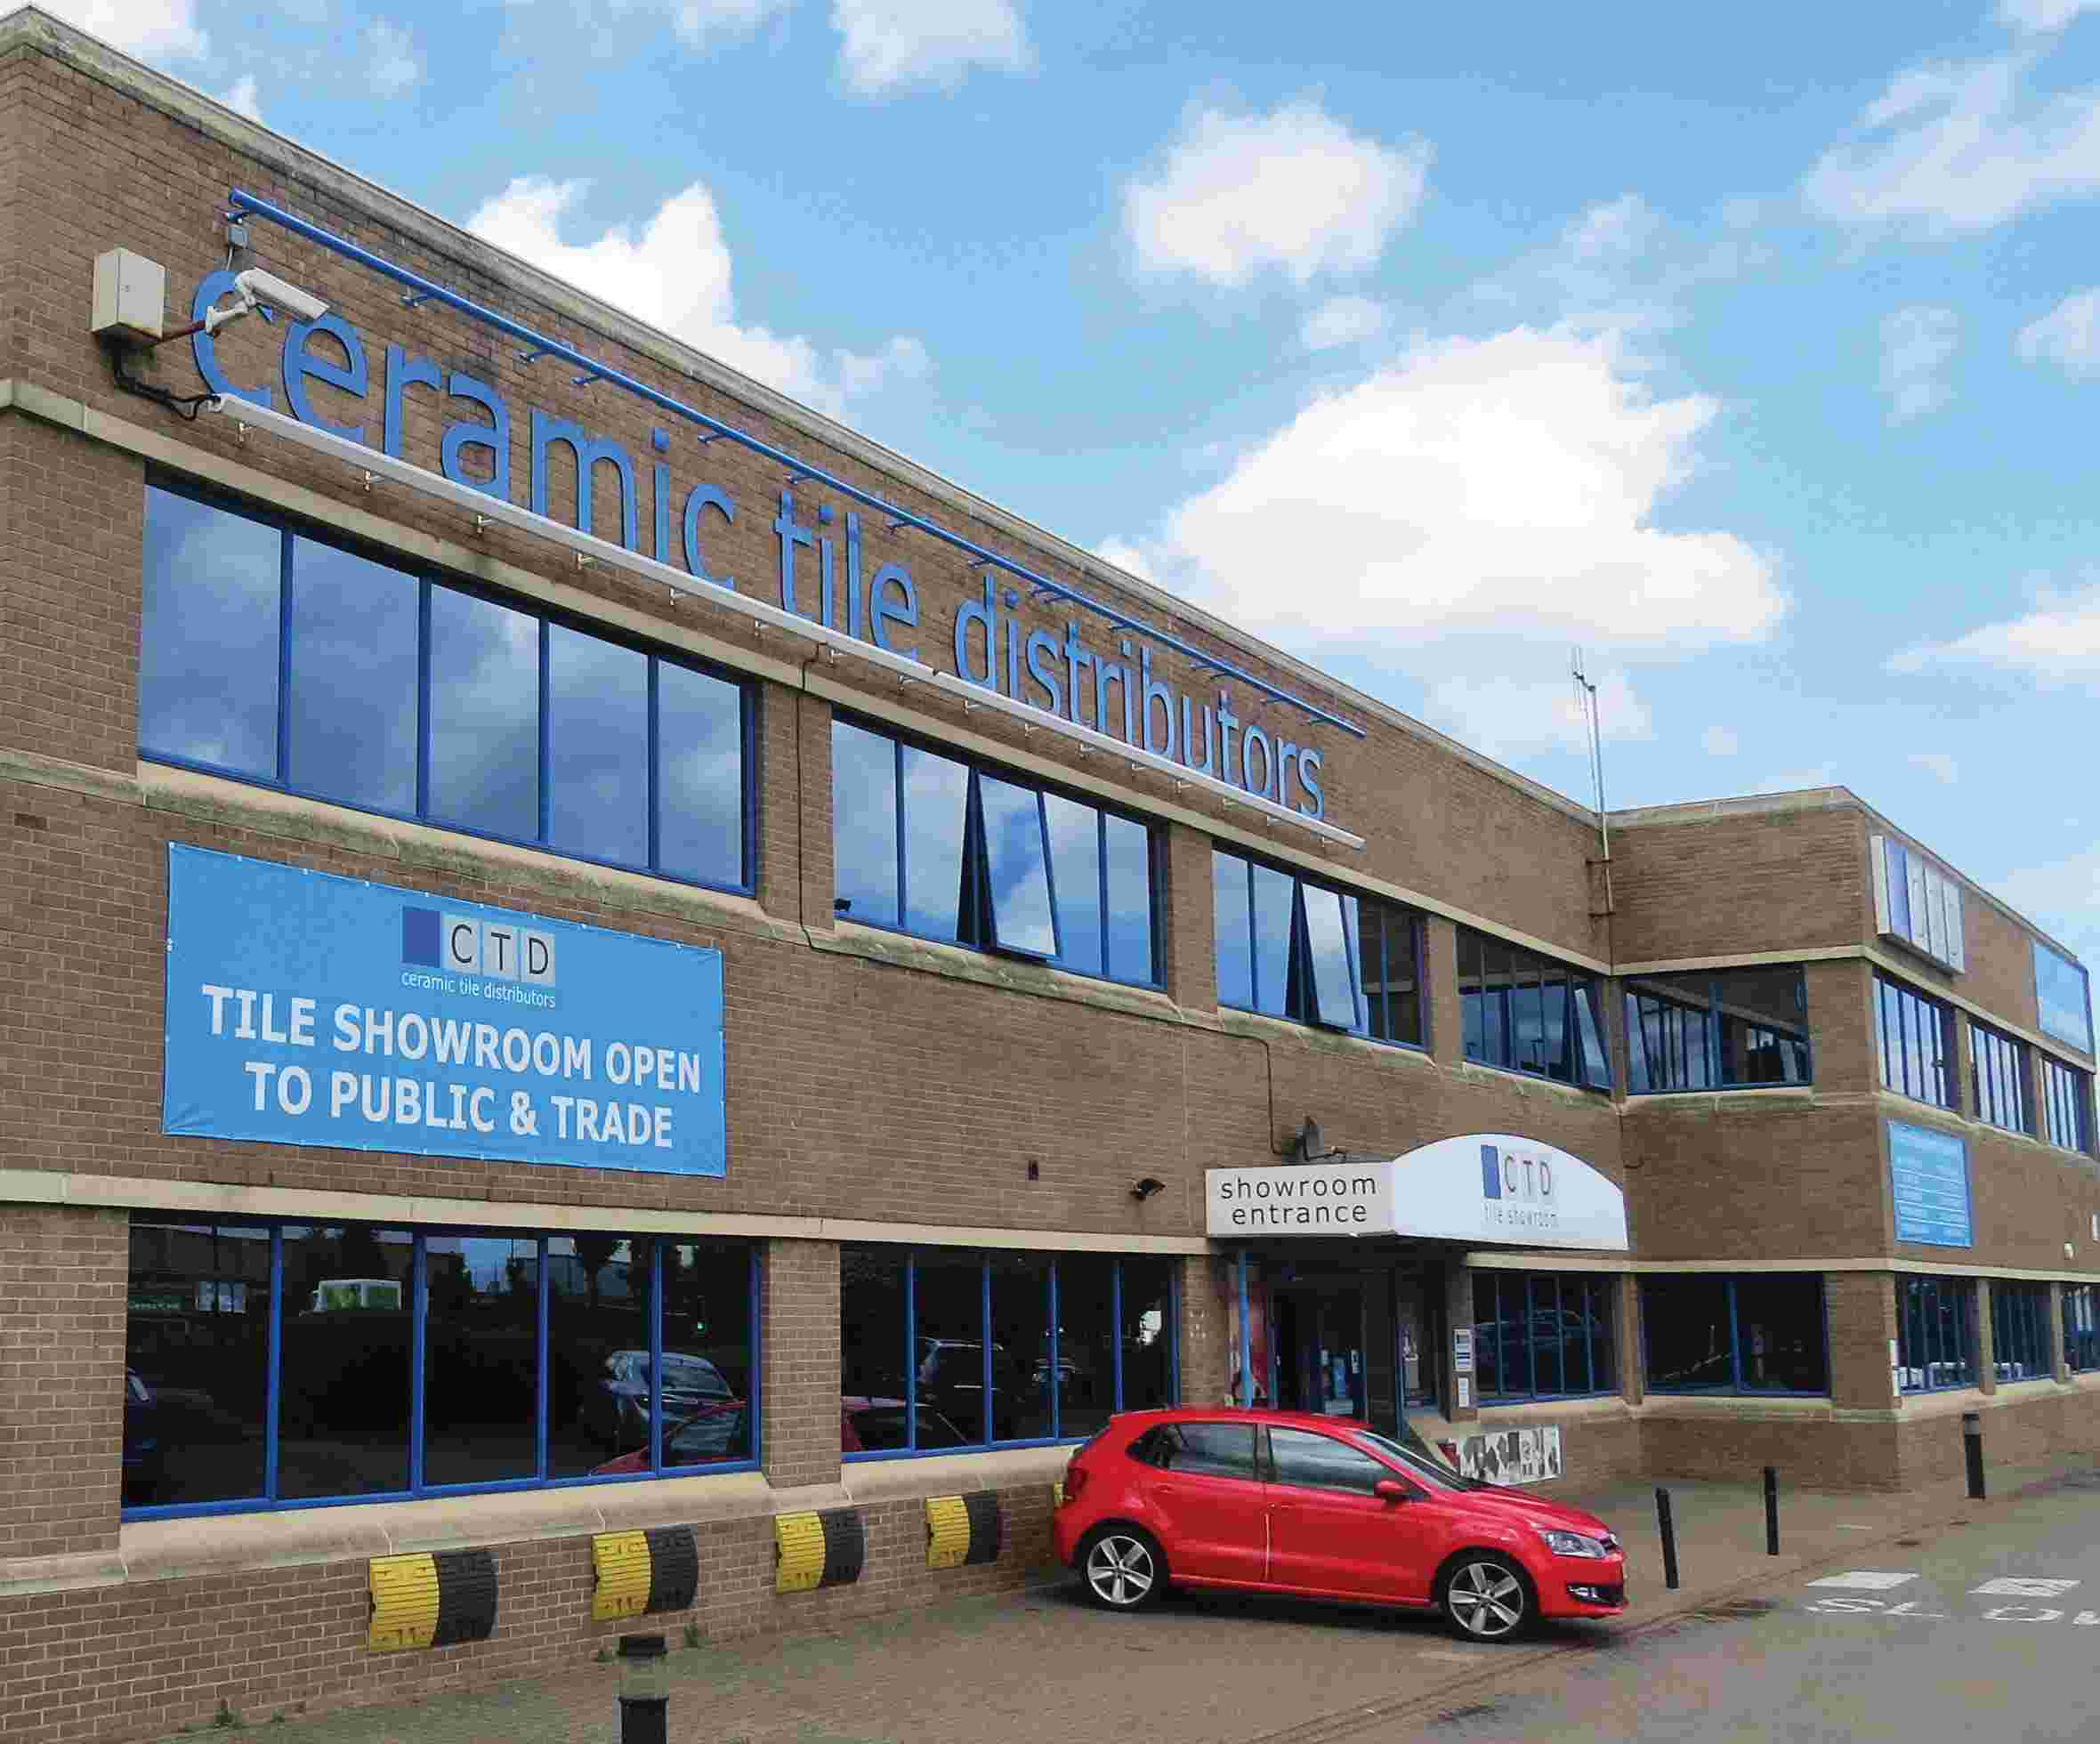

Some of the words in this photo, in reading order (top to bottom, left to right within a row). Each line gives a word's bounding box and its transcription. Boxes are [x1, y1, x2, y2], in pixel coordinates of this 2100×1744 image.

[192, 270, 735, 601] ceramic
[773, 490, 919, 666] tile
[954, 569, 1325, 822] distributors
[451, 924, 549, 975] CTD
[400, 972, 456, 994] ceramic
[459, 976, 480, 997] tile
[483, 981, 556, 1008] distributors
[201, 983, 317, 1046] TILE
[333, 1003, 592, 1081] SHOWROOM
[605, 1041, 700, 1094] OPEN
[245, 1061, 313, 1116] TO
[329, 1070, 496, 1134] PUBLIC
[508, 1090, 540, 1137] &
[550, 1094, 674, 1148] TRADE
[1220, 1176, 1377, 1199] showroom
[1504, 1154, 1552, 1196] CTD
[1232, 1204, 1368, 1225] entrance
